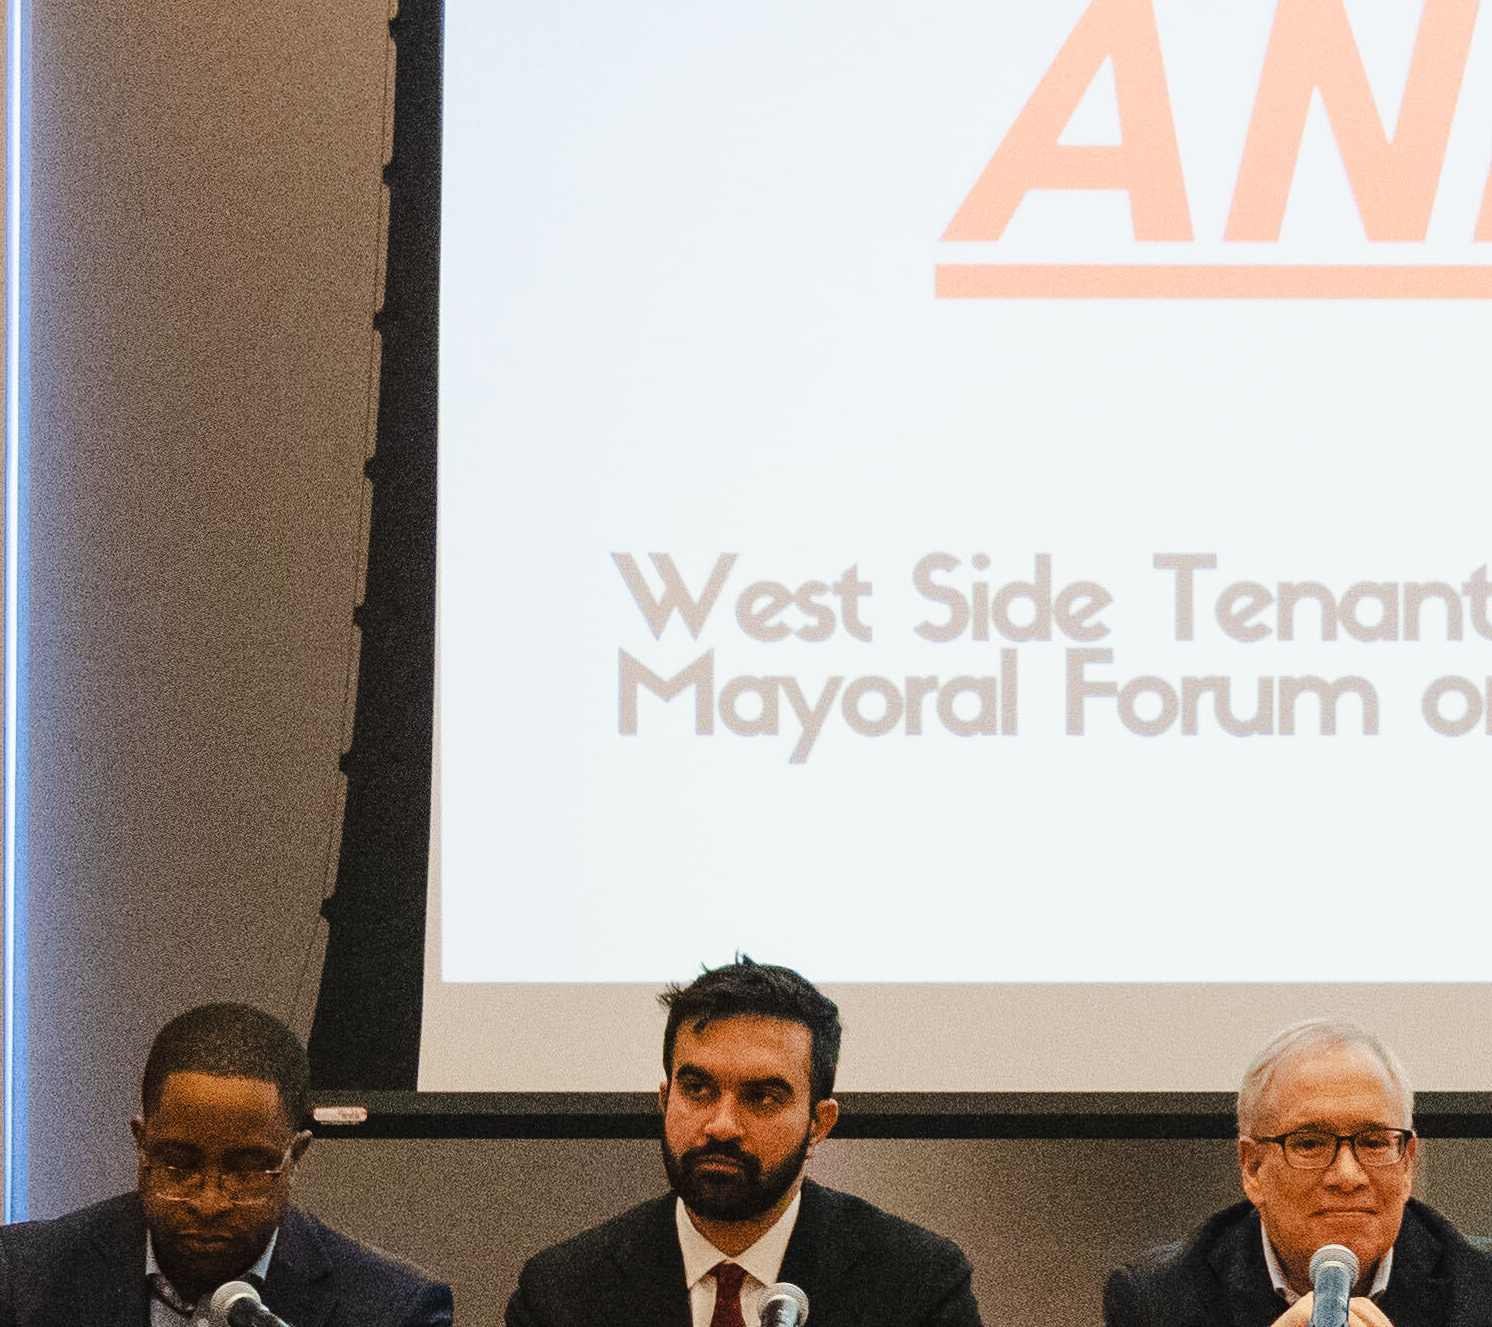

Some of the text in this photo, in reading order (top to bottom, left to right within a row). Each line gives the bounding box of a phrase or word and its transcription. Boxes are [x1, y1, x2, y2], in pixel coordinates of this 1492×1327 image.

[609, 551, 874, 644] West
[912, 550, 1115, 644] Side
[617, 648, 1020, 766] Mayoral
[1065, 648, 1381, 739] Forum
